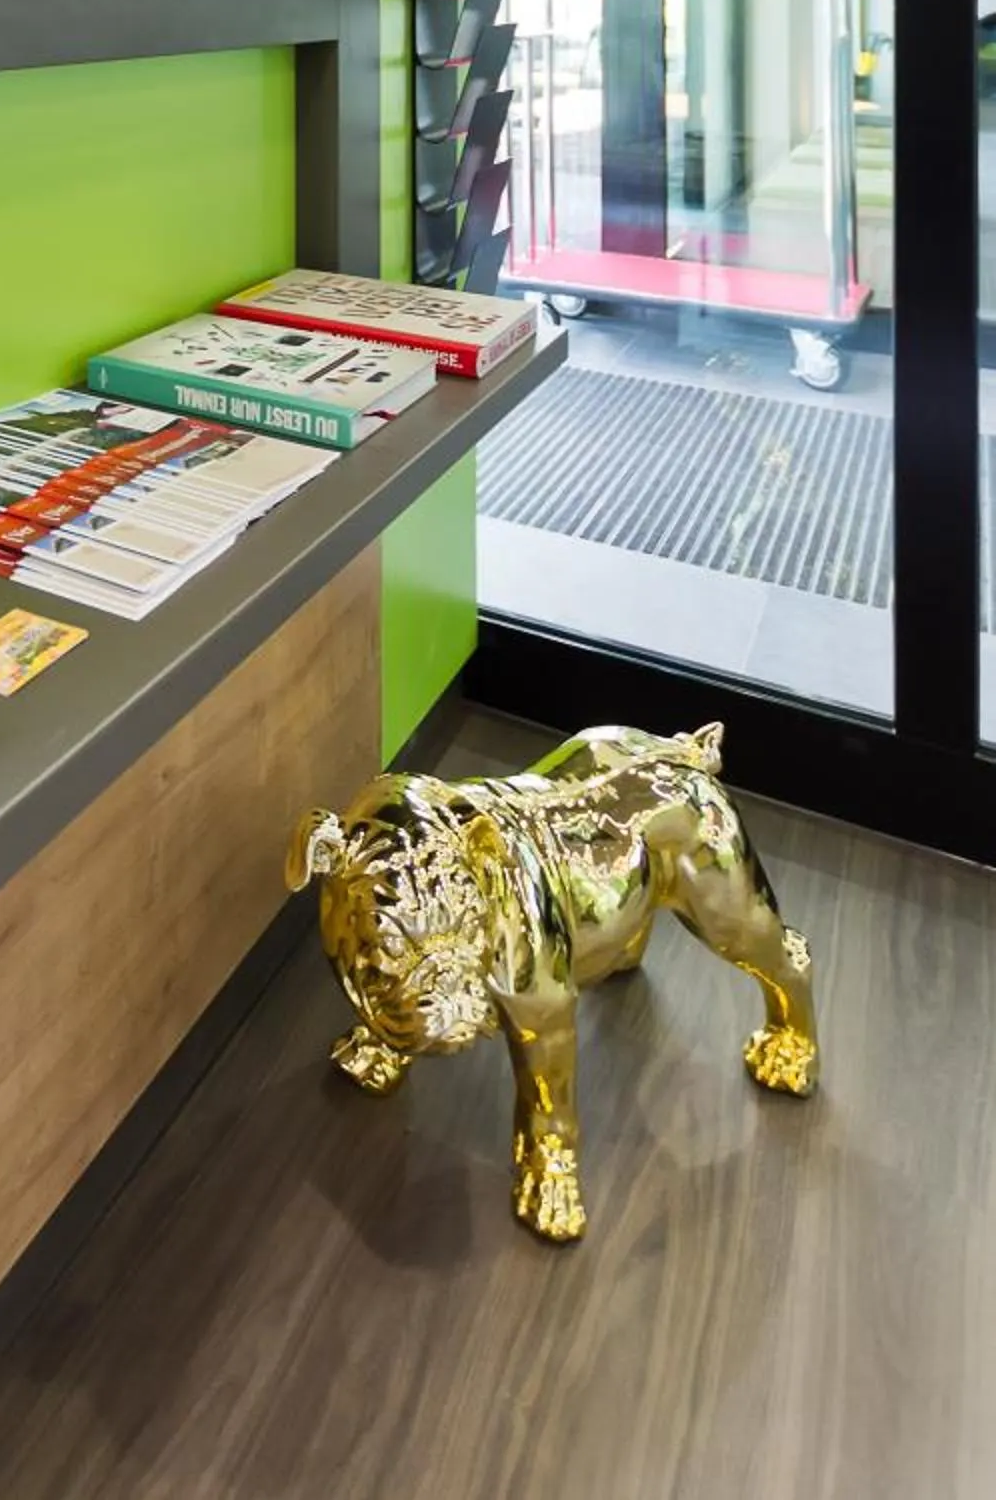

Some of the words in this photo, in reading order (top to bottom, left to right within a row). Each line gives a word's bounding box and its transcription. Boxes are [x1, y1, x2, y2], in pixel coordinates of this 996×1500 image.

[174, 385, 227, 415] EINMAL
[230, 397, 260, 423] NUR
[264, 404, 312, 434] LEBST
[315, 415, 338, 440] DU
